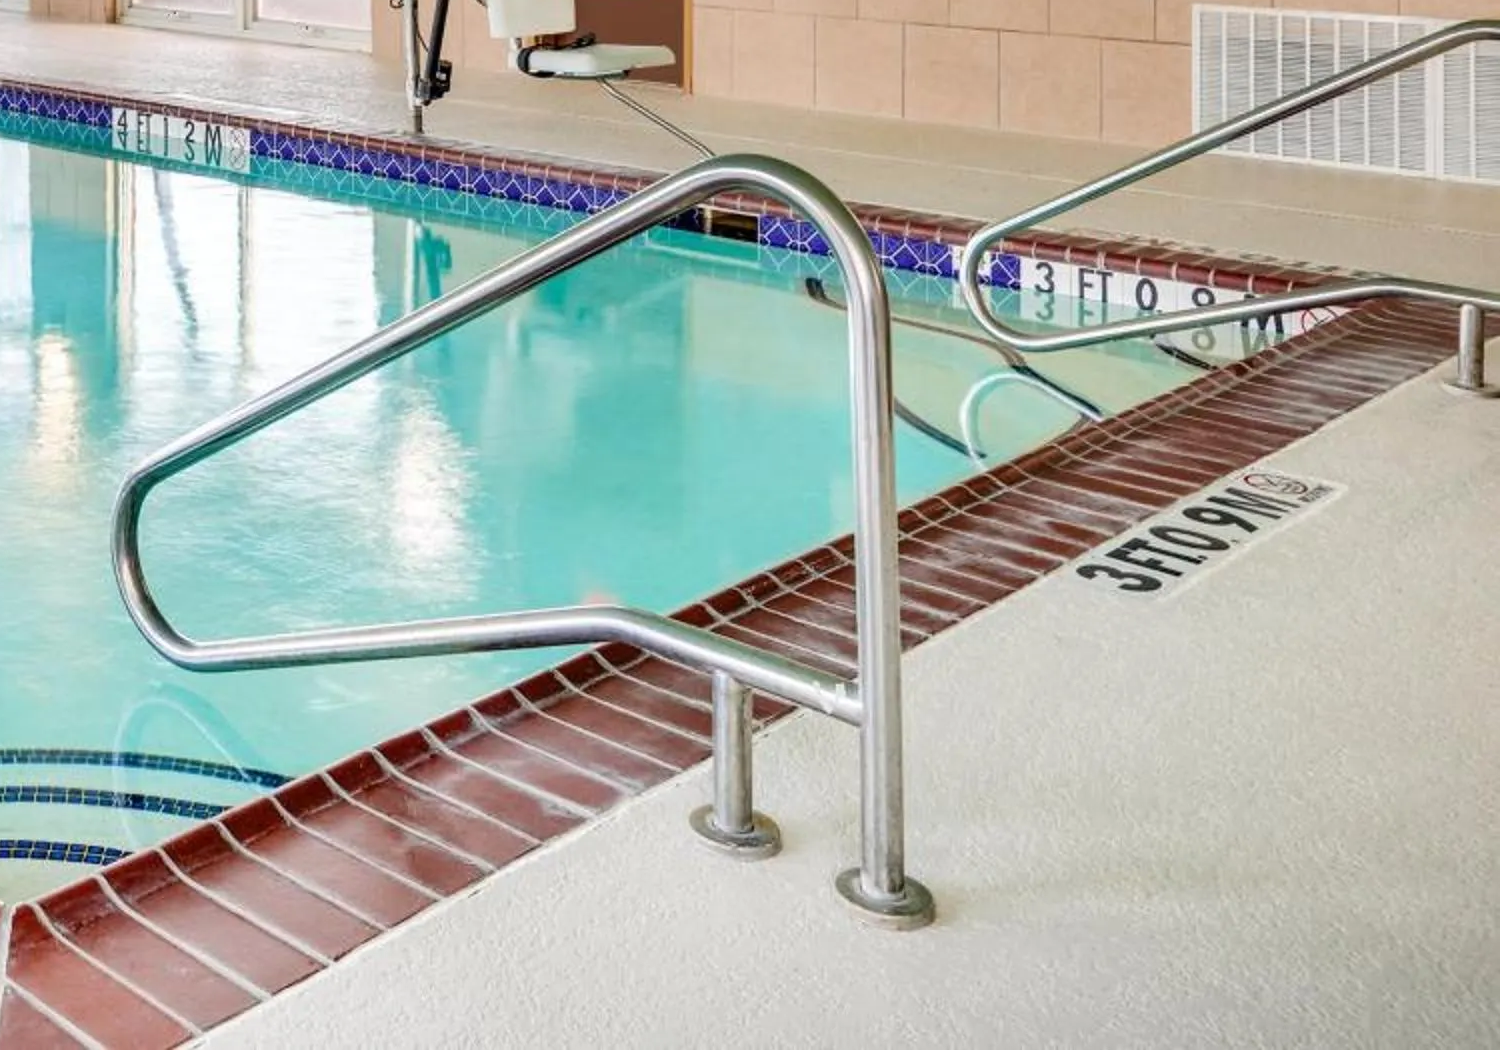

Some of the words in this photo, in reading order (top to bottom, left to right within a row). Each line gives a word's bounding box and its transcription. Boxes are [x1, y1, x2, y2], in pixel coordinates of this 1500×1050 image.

[1034, 262, 1054, 293] 3
[1079, 268, 1113, 303] FT
[1076, 564, 1162, 593] 3
